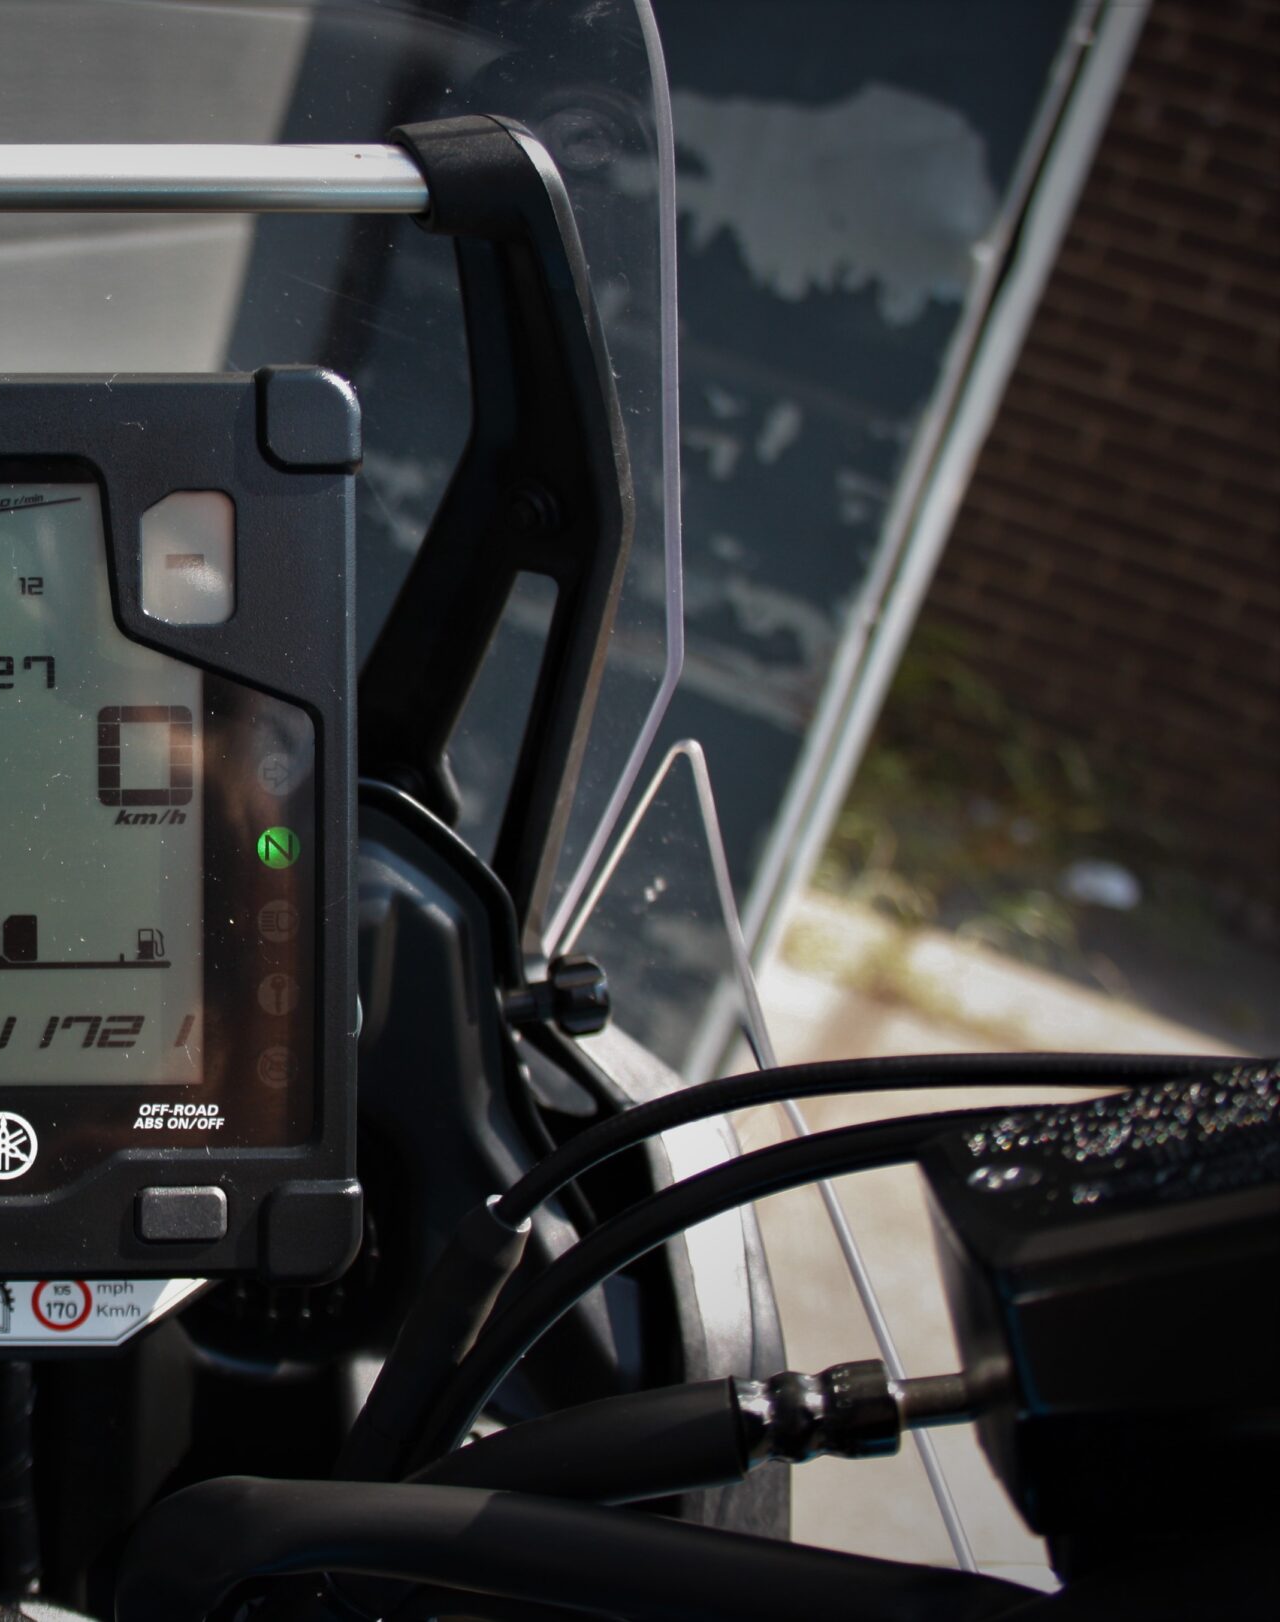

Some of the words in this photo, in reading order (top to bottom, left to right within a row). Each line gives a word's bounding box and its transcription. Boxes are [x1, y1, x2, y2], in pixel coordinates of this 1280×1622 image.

[14, 494, 44, 506] r/min
[20, 577, 44, 595] 12
[115, 810, 187, 826] km/h
[265, 834, 294, 862] N
[139, 1103, 220, 1117] OFF-ROAD
[133, 1117, 164, 1130] ABS
[167, 1117, 226, 1130] ON/OFF
[53, 1285, 72, 1296] 105
[97, 1282, 134, 1297] mph
[46, 1302, 78, 1319] 170
[96, 1303, 141, 1318] Km/h
